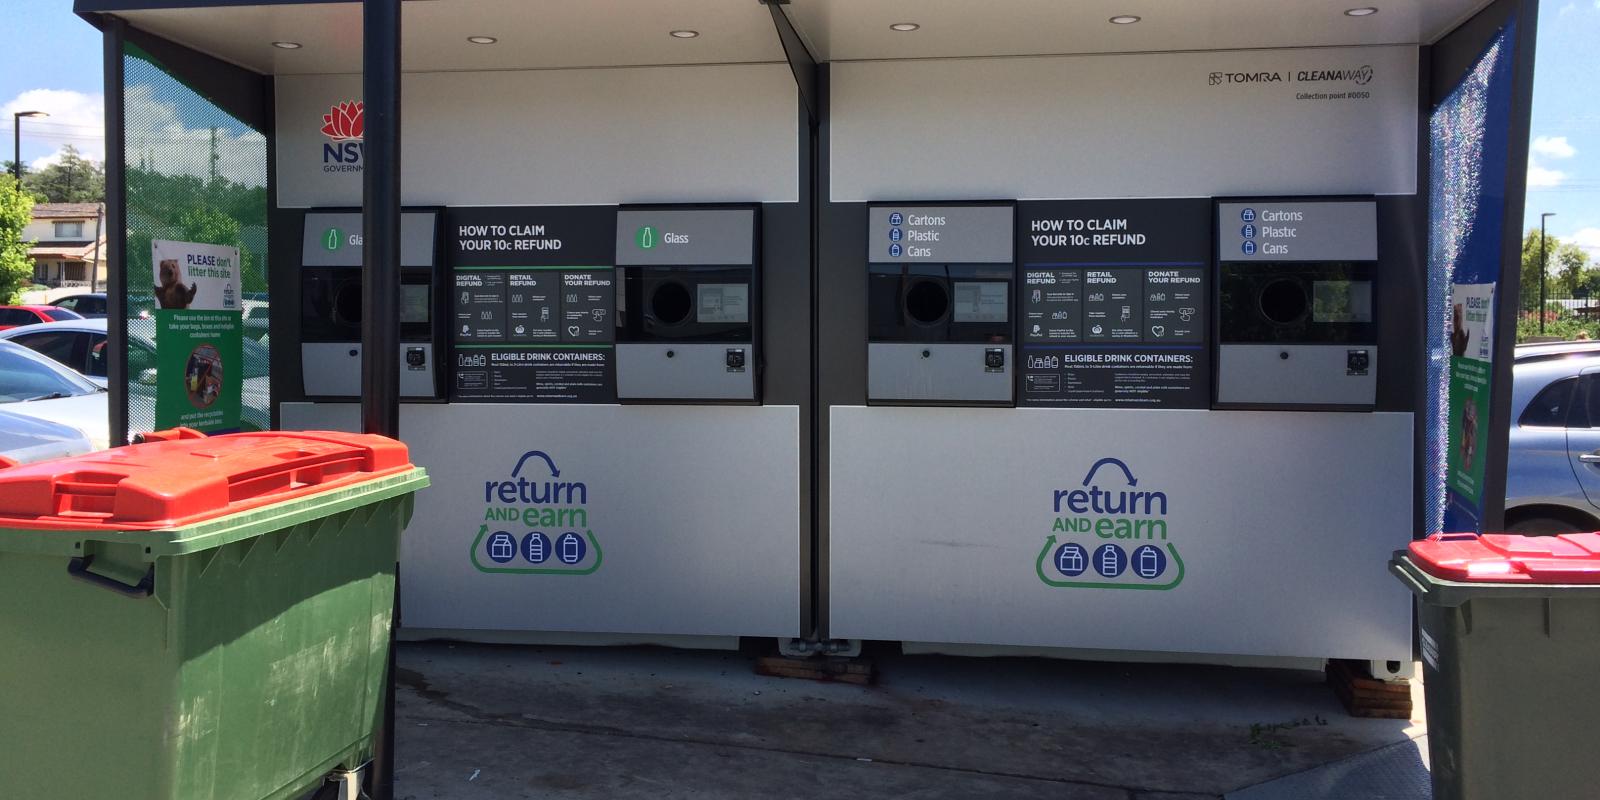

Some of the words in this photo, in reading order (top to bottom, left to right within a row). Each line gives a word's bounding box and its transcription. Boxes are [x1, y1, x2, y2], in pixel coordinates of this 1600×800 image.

[1225, 72, 1282, 83] TOMRA
[1297, 70, 1368, 81] CLEANAWAY
[1296, 92, 1328, 100] Collection
[1329, 92, 1346, 101] point
[908, 214, 946, 226] Cartons
[1262, 210, 1303, 222] Cartons
[459, 226, 488, 236] HOW
[490, 226, 506, 236] TO
[509, 225, 545, 236] CLAIM
[1031, 220, 1063, 232] HOW
[1067, 220, 1084, 231] TO
[1087, 219, 1127, 231] CLAIM
[664, 232, 689, 244] Glass
[908, 230, 940, 242] Plastic
[1262, 226, 1297, 238] Plastic
[350, 234, 363, 246] Gla
[459, 240, 491, 250] YOUR
[494, 240, 512, 250] 10c
[514, 239, 561, 250] REFUND
[1031, 235, 1067, 246] YOUR
[1070, 235, 1090, 246] 10c
[1093, 234, 1146, 246] REFUND
[908, 246, 931, 257] Cans
[1263, 243, 1288, 254] Cans
[187, 254, 216, 266] PLEASE
[216, 258, 232, 268] don't
[188, 266, 206, 277] litter
[208, 268, 220, 278] this
[220, 268, 231, 279] site
[1466, 297, 1481, 309] PLEASE
[491, 353, 526, 361] ELIGIBLE
[527, 353, 552, 361] DRINK
[553, 353, 606, 361] CONTAINERS:
[1065, 354, 1103, 362] ELIGIBLE
[1105, 355, 1132, 363] DRINK
[1134, 355, 1193, 363] CONTAINERS:
[485, 477, 587, 504] return
[1054, 486, 1167, 515] return
[485, 508, 520, 521] AND
[522, 507, 587, 528] earn
[1052, 517, 1092, 533] AND
[1095, 518, 1167, 540] earn
